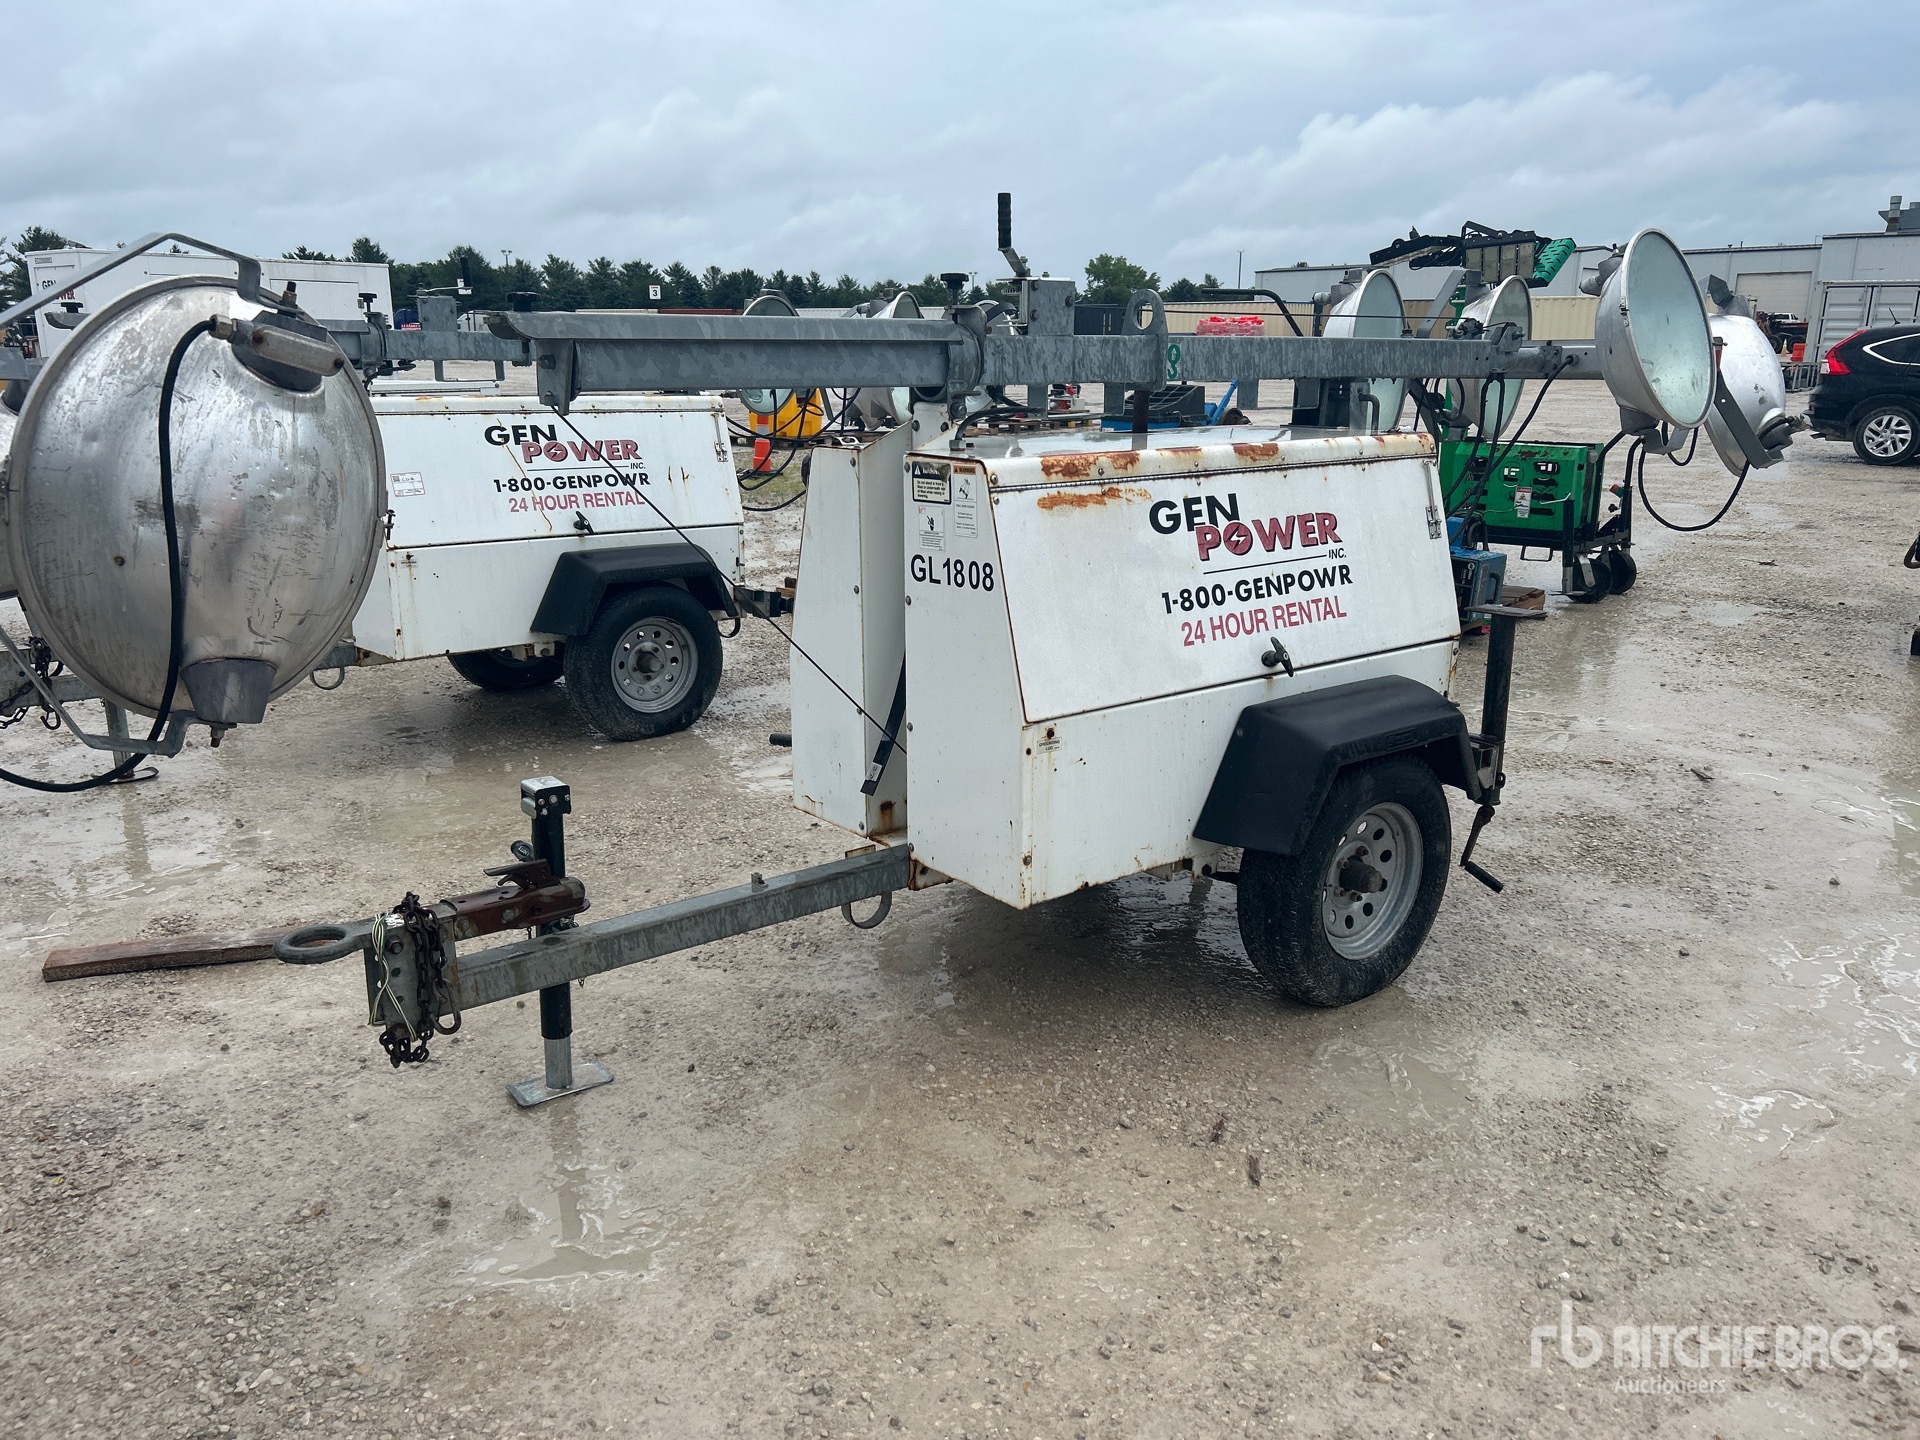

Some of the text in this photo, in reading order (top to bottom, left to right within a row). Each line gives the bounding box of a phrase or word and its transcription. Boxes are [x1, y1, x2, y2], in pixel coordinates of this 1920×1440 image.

[484, 424, 558, 446] GEN
[520, 439, 643, 463] POWER
[630, 462, 646, 470] INC.
[493, 472, 651, 492] 1-800-GENPOWR
[508, 491, 645, 513] 24 HOUR RENTAL
[1149, 493, 1240, 535] GEN
[1194, 512, 1343, 562] POWER
[1328, 548, 1347, 560] INC.
[910, 553, 995, 592] GL1808
[1161, 564, 1353, 615] 1-800-GENPOWR
[1181, 595, 1348, 647] 24 HOUR RENTAL
